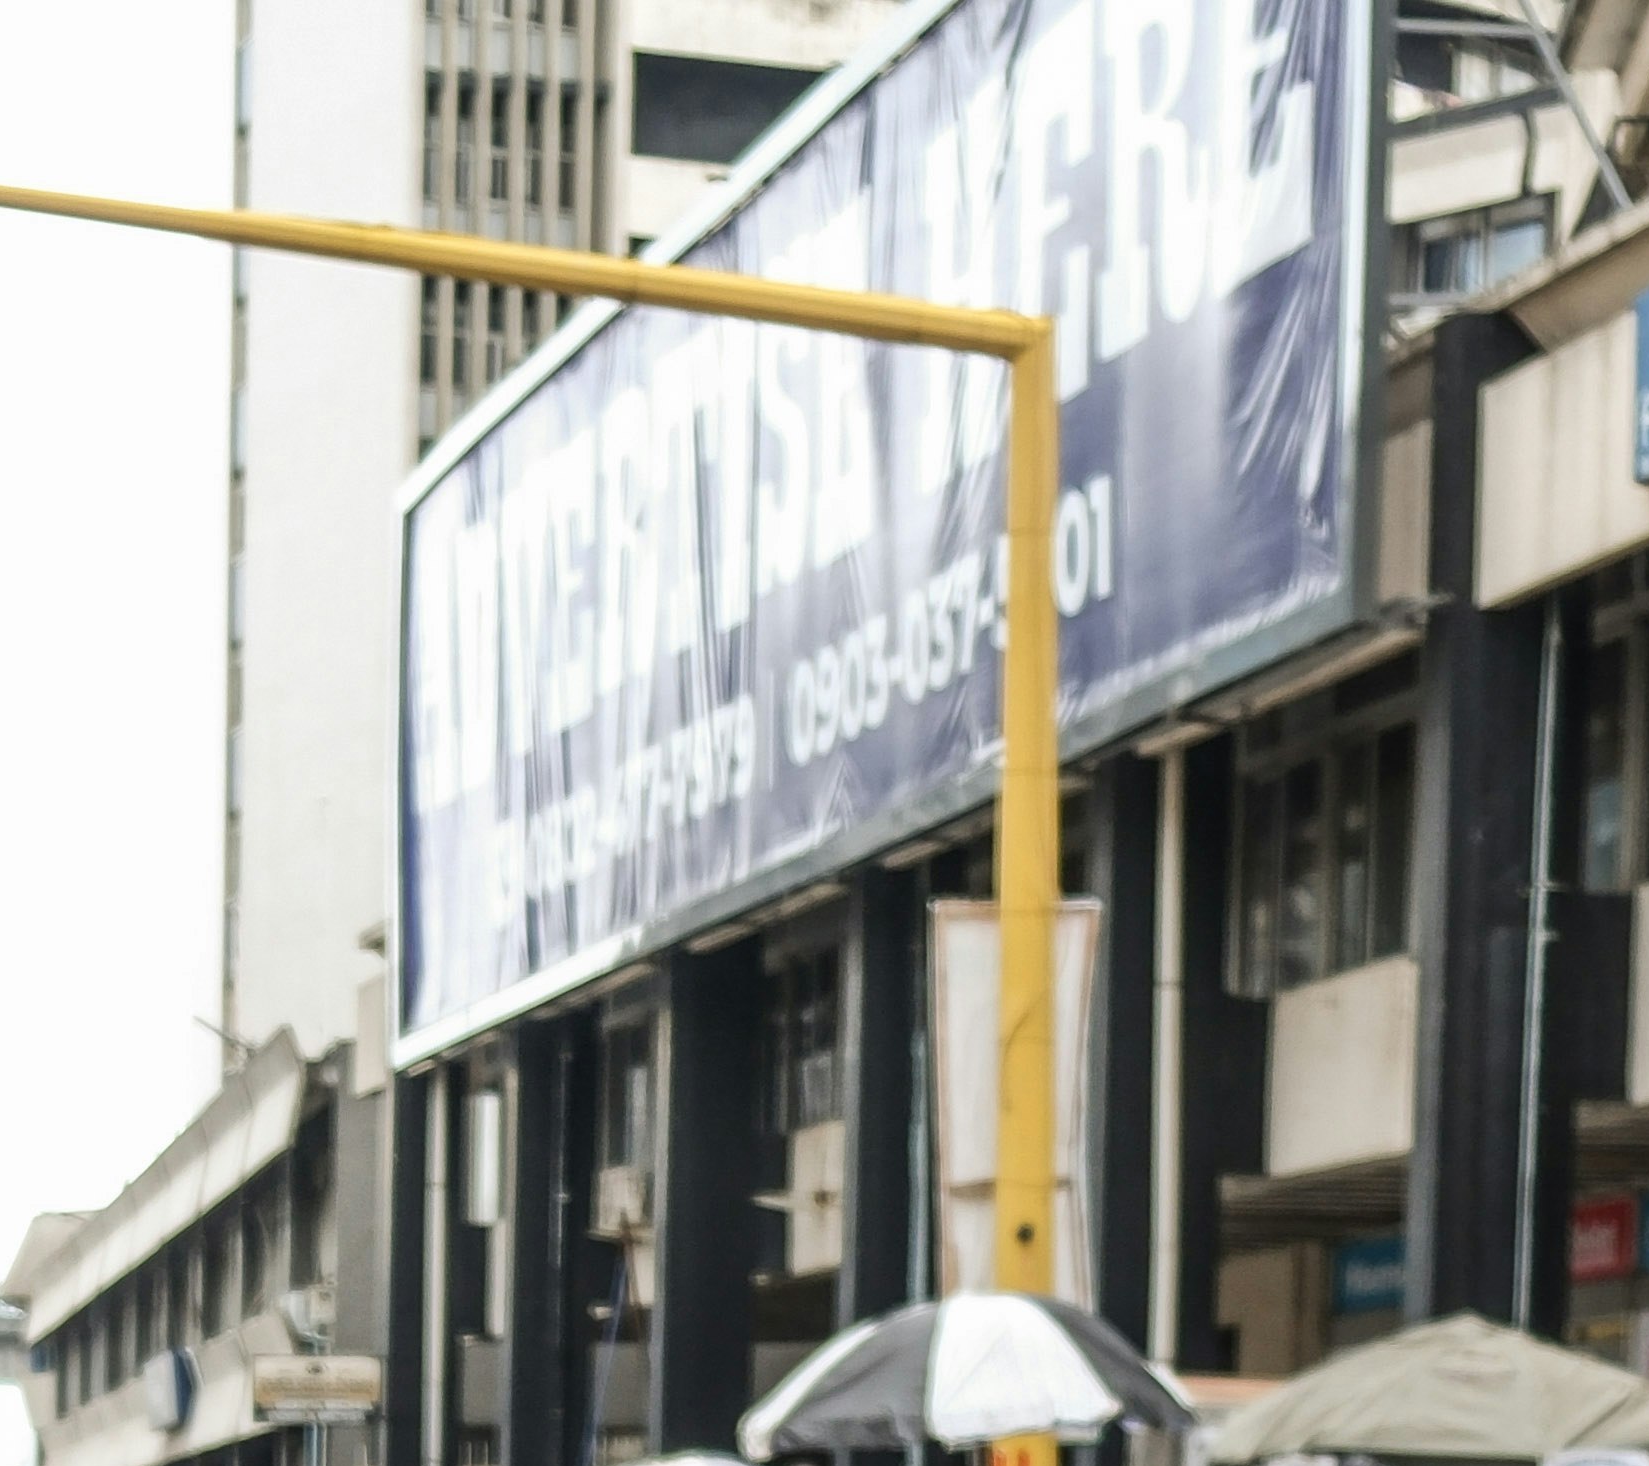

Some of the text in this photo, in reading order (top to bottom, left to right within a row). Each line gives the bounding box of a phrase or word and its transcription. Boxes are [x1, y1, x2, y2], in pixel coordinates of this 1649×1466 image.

[414, 0, 1314, 815] ADVERTISE HERE
[786, 473, 1115, 766] 0903-037-01
